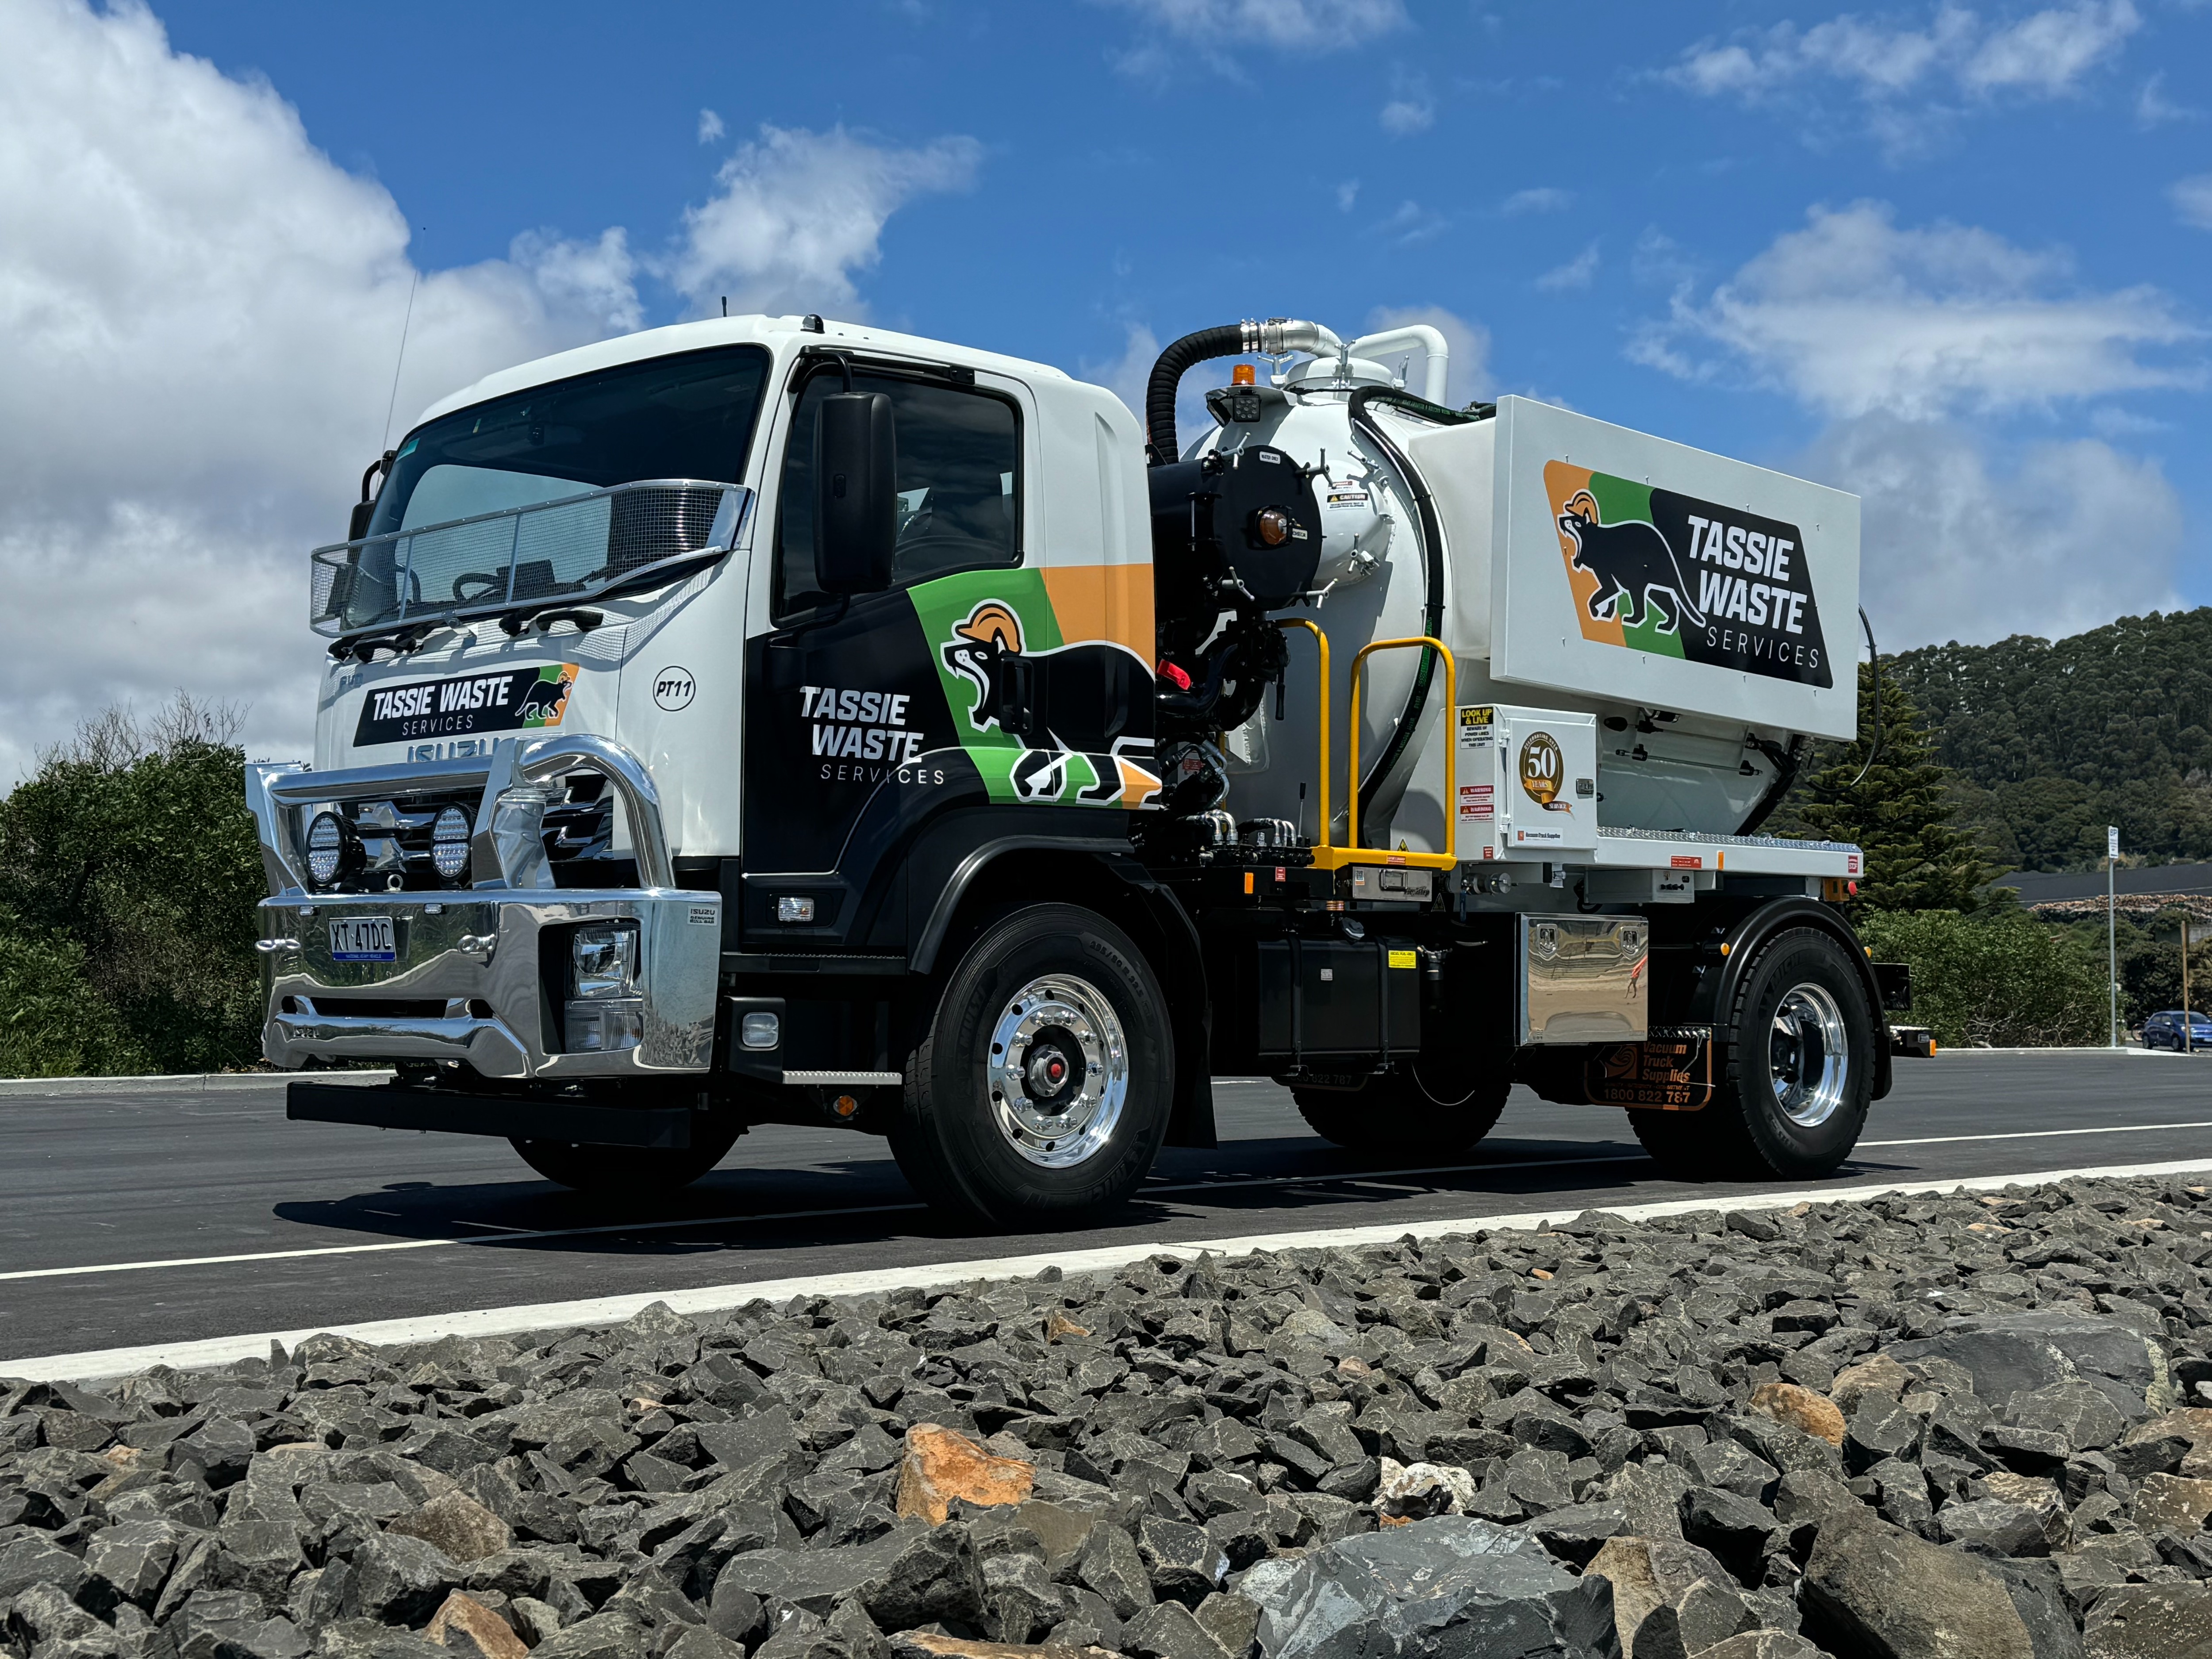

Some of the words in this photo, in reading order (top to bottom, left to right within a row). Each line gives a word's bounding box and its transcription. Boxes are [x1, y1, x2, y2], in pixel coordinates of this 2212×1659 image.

[1688, 515, 1794, 581] TASSIE
[1699, 569, 1807, 634] WASTE
[1706, 626, 1819, 668] SERVICES
[373, 686, 435, 721] TASSIE
[440, 676, 513, 712] WASTE
[656, 680, 691, 697] PT11
[799, 686, 910, 726] TASSIE
[402, 714, 474, 736] SERVICES
[812, 724, 924, 763] WASTE
[821, 764, 944, 784] SERVICES
[1528, 745, 1556, 779] 50
[1643, 1041, 1687, 1054] Vacuum
[1643, 1055, 1674, 1067] Truck
[1642, 1069, 1690, 1083] Supplies
[1604, 1088, 1634, 1100] 1800
[1638, 1090, 1662, 1102] 822
